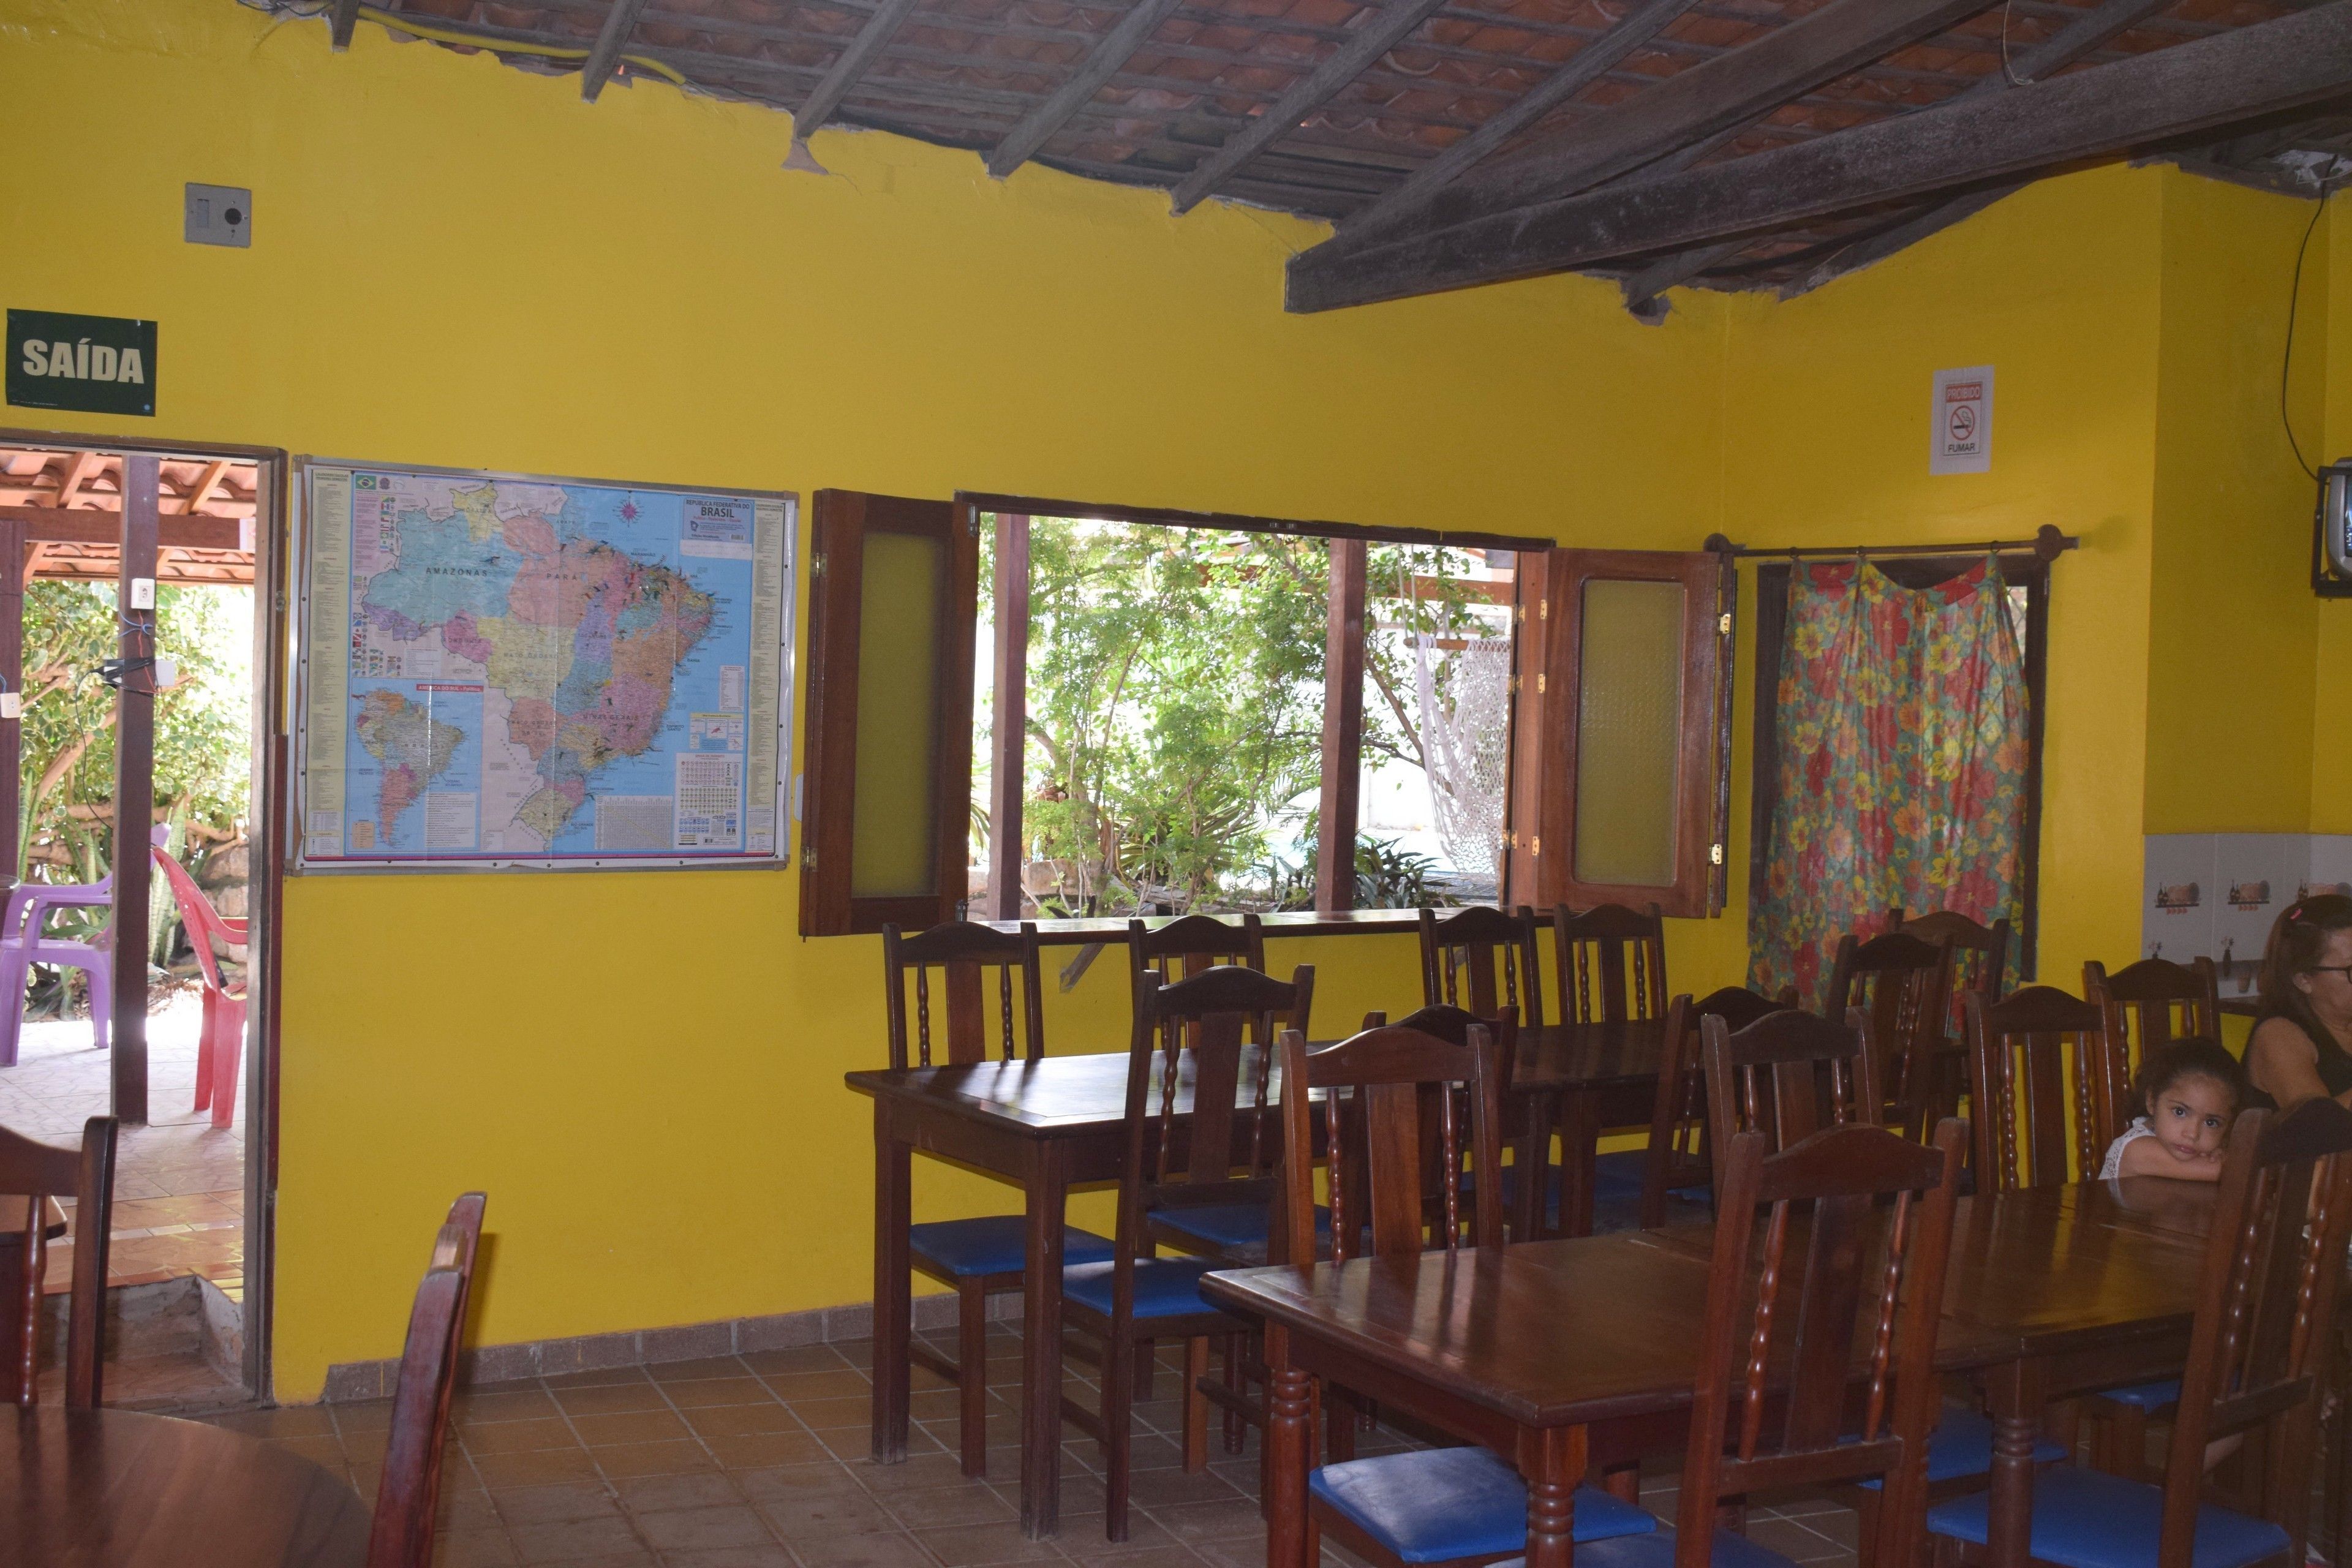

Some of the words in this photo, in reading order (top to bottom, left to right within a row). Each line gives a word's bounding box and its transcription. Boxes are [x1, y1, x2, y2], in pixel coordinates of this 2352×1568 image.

[23, 337, 144, 384] SAÍDA
[1947, 386, 1980, 398] PROIBIDO
[1948, 443, 1975, 453] FUMAR
[701, 507, 734, 518] BRASIL
[426, 567, 488, 576] AMAZONAS
